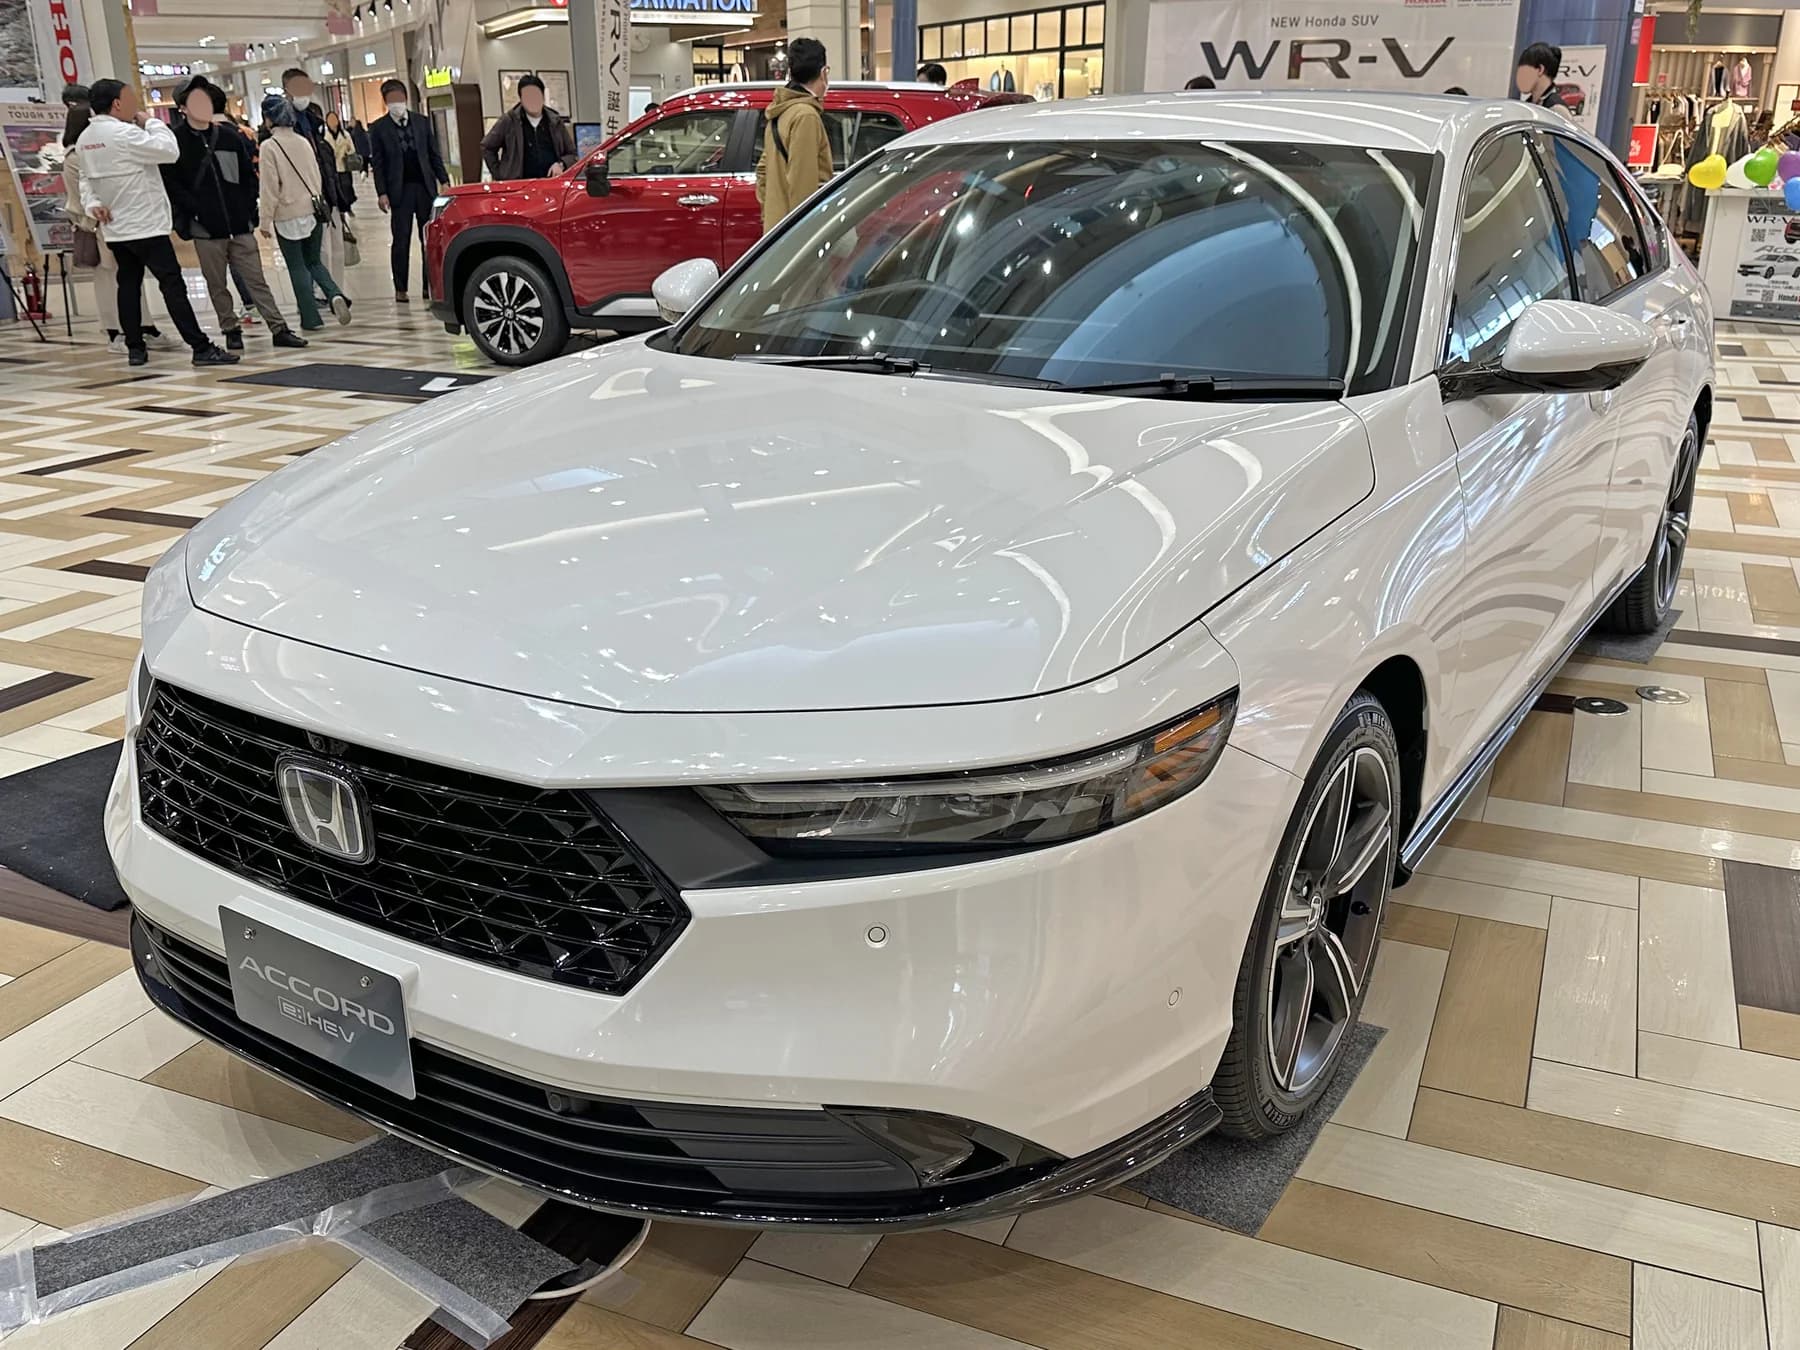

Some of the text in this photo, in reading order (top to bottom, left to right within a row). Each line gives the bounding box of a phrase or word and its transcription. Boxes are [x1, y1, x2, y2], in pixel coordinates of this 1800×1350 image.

[1271, 15, 1379, 28] NEW Honda SUV
[1200, 36, 1455, 81] WR-V
[1558, 65, 1596, 77] R-V
[8, 111, 44, 119] TOUGH
[239, 955, 395, 1036] ACCORD
